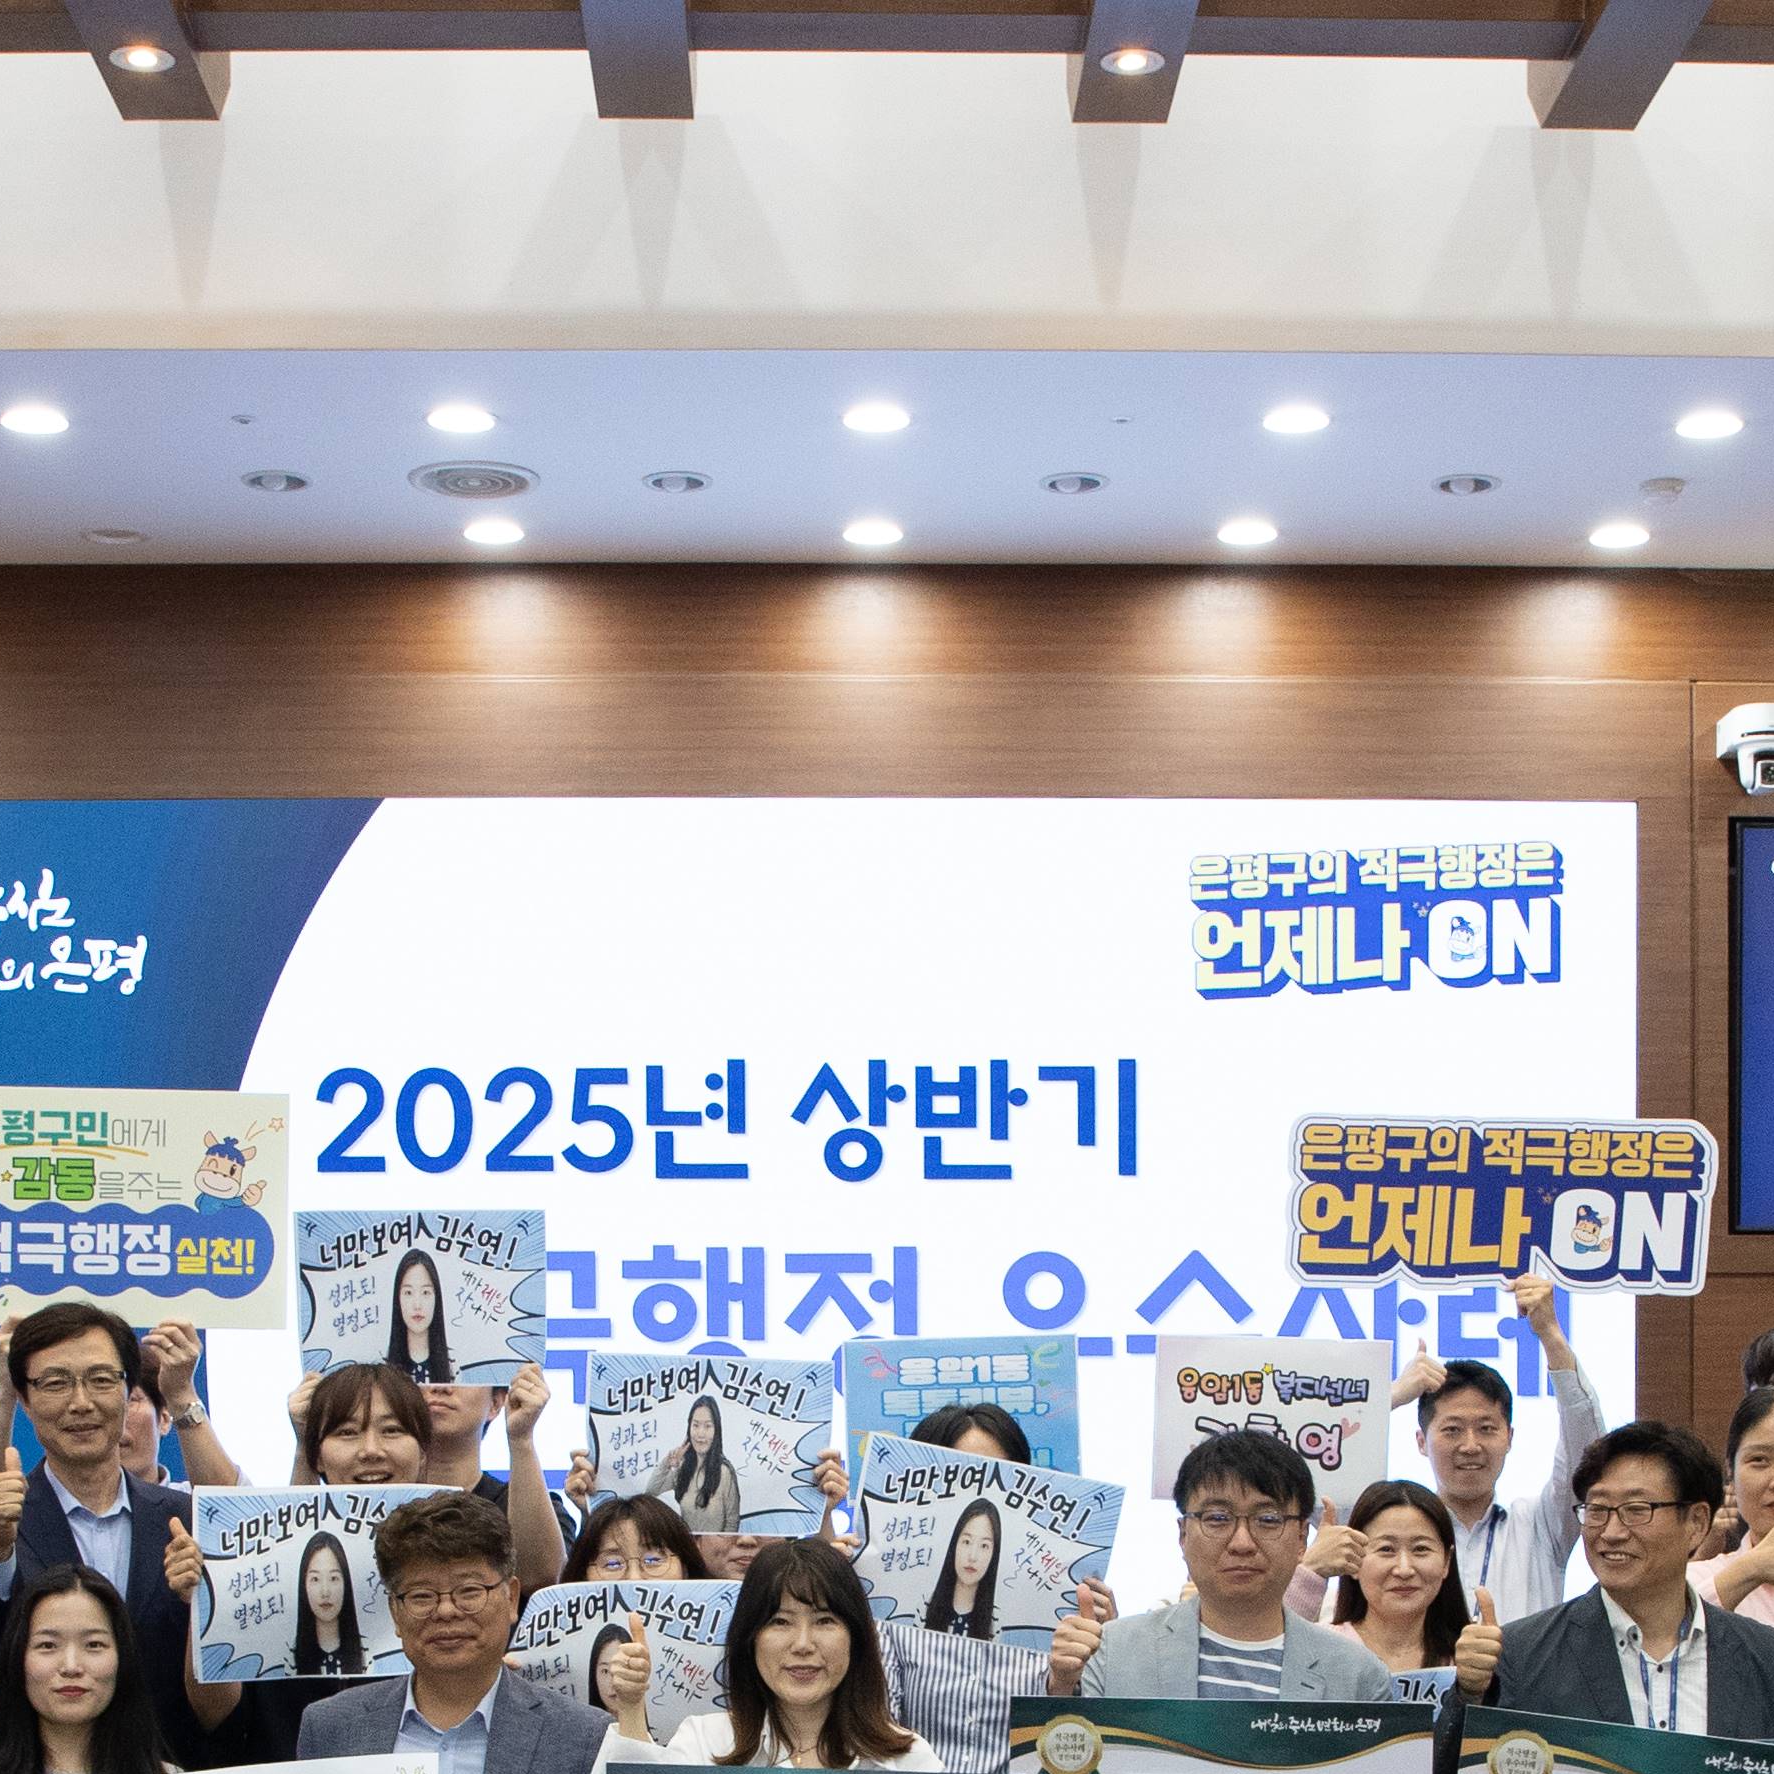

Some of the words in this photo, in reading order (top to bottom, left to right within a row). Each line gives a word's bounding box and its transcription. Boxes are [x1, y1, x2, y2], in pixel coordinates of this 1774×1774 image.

[1189, 854, 1347, 901] 은평구의
[1358, 841, 1562, 892] 적극행정은
[41, 936, 149, 996] 은평
[1193, 901, 1411, 994] 언제나
[1426, 897, 1560, 986] ON
[315, 1059, 749, 1181] 2025년
[791, 1058, 1138, 1183] 상반기
[1299, 1124, 1469, 1175] 은평구의
[1482, 1130, 1699, 1180] 적극행정은
[175, 1235, 256, 1277] 실천!
[1298, 1182, 1532, 1270] 언제나
[1553, 1187, 1691, 1276] ON
[1177, 1366, 1264, 1405] 응암1동
